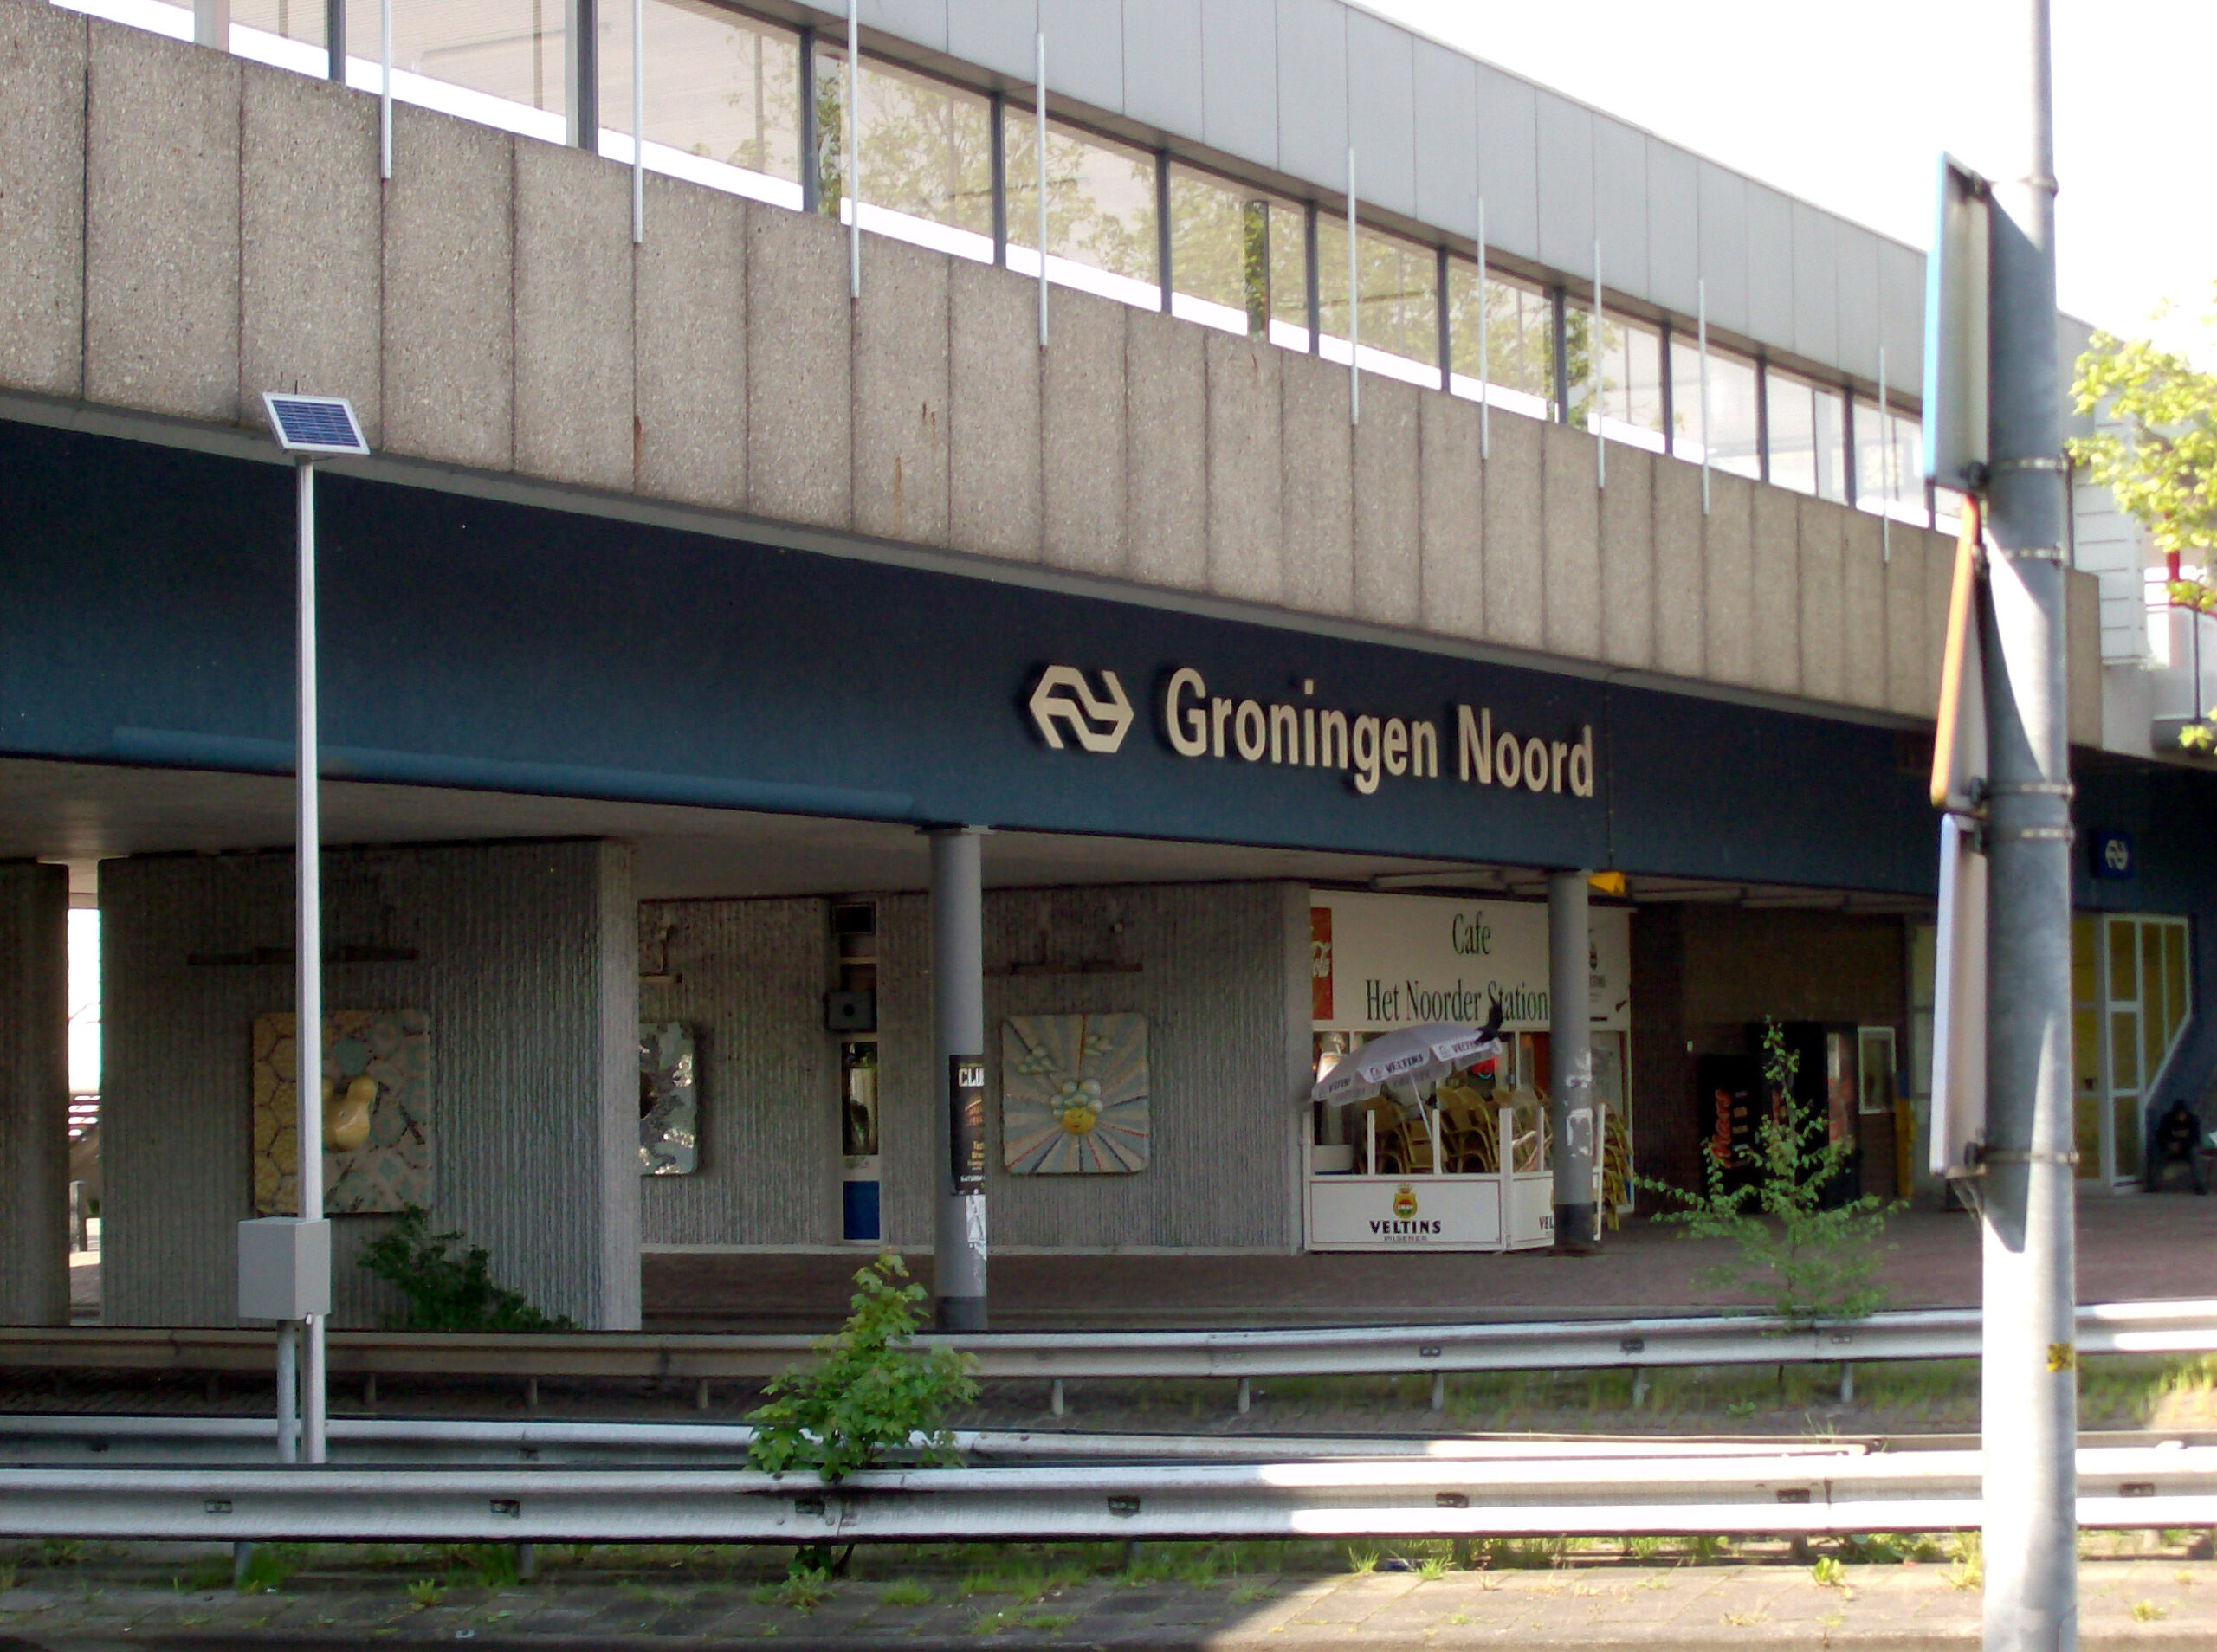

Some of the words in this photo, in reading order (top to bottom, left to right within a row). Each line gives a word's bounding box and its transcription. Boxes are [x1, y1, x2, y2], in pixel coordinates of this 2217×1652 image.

[1166, 666, 1438, 795] Groningen
[1458, 703, 1594, 797] Noord
[1365, 979, 1399, 1022] Het
[1406, 977, 1482, 1023] Noorder
[1385, 1053, 1425, 1074] VELTINS
[1369, 1219, 1442, 1235] VELTINS
